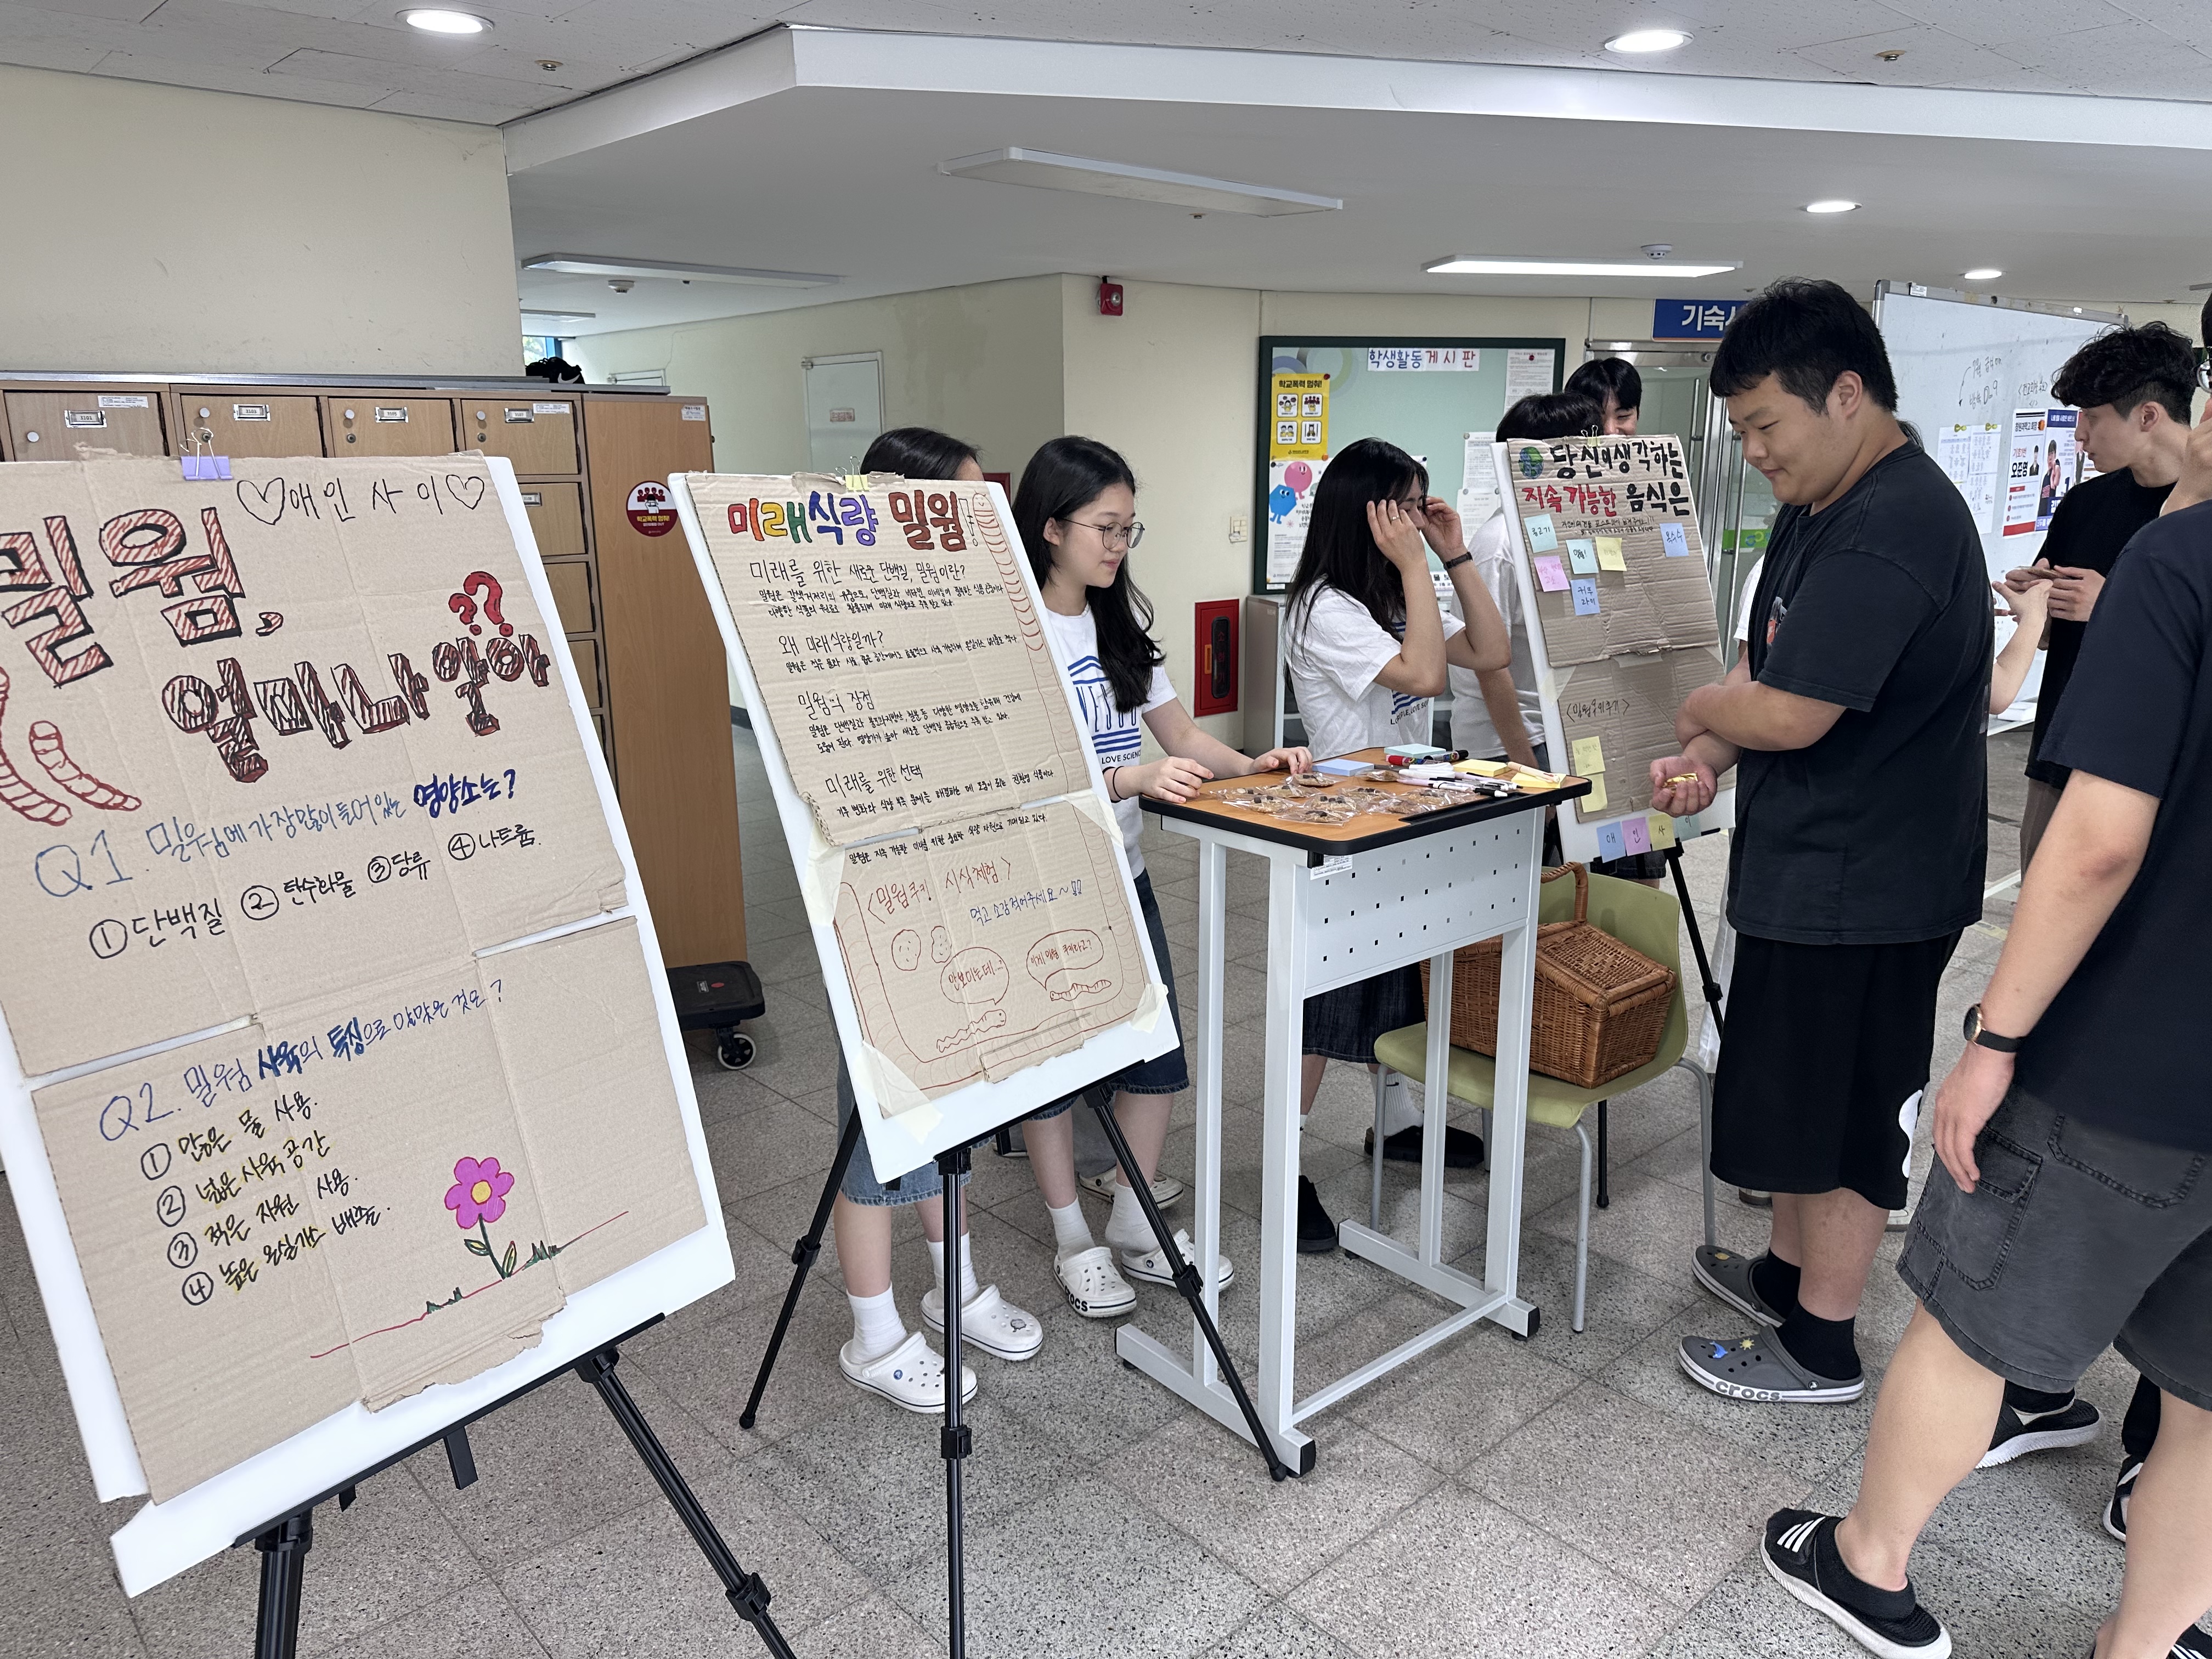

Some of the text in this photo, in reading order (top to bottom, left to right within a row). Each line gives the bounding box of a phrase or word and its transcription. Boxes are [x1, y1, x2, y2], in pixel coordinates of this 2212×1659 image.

[1369, 350, 1422, 369] 학생활동
[2011, 461, 2028, 478] 오준영
[1522, 484, 1562, 514] 지속
[1563, 483, 1617, 517] 가능한
[1626, 482, 1690, 517] 음식은
[727, 490, 879, 547] 미래식량
[1531, 527, 1550, 537] 콩고기
[1666, 529, 1683, 544] 옥수수
[750, 559, 966, 588] 미래를 위한 새로운 단백질, 밀웜이란?
[759, 589, 785, 602] 밀웜은
[871, 586, 900, 600] 단백질과
[768, 605, 793, 618] 다양한
[795, 604, 817, 617] 식품의
[819, 603, 840, 613] 원료로
[847, 602, 874, 613] 활용되며
[879, 600, 893, 610] 미래
[779, 635, 800, 657] 왜
[786, 661, 806, 674] 밀웜은
[965, 639, 986, 651] 온실가스
[161, 653, 430, 783] 얼마나
[798, 689, 875, 720] 밀웜의 장점
[809, 724, 831, 738] 밀웜은
[834, 718, 865, 733] 단백질과
[921, 708, 928, 721] 등
[933, 704, 953, 717] 다양한
[955, 701, 980, 714] 영양소를
[1003, 692, 1022, 704] 건강에
[816, 741, 836, 754] 도움이
[857, 732, 882, 744] 영양가가
[902, 725, 920, 736] 새로운
[923, 721, 943, 734] 단백질
[1102, 755, 1121, 764] LOVE
[825, 764, 924, 798] 미래를 위한 선택
[837, 806, 850, 818] 기후
[851, 802, 877, 816] 변화와
[881, 797, 894, 811] 식량
[896, 796, 908, 808] 부족
[910, 791, 932, 806] 문제를
[935, 786, 961, 799] 해결하는
[977, 780, 993, 792] 도움이
[995, 777, 1007, 789] 되는
[146, 816, 247, 862] 밀웜에
[414, 769, 516, 818] 영양소는?
[849, 851, 872, 865] 밀웜은
[874, 848, 888, 859] 지속
[968, 824, 980, 836] 식량
[983, 821, 1004, 833] 자원으로
[970, 906, 992, 926] 먹고
[994, 900, 1010, 918] 소감
[1030, 951, 1046, 967] 이게
[184, 1058, 253, 1107] 밀웜
[326, 1016, 391, 1062] 특징으로
[393, 1000, 449, 1031] 알맞은
[179, 1126, 232, 1162] 많은
[239, 1109, 266, 1139] 물
[195, 1130, 330, 1204] 넓은 사육 공간
[205, 1214, 251, 1246] 적은
[219, 1258, 259, 1290] 높은
[263, 1226, 326, 1266] 온실가스
[1716, 1381, 1780, 1401] crocs
